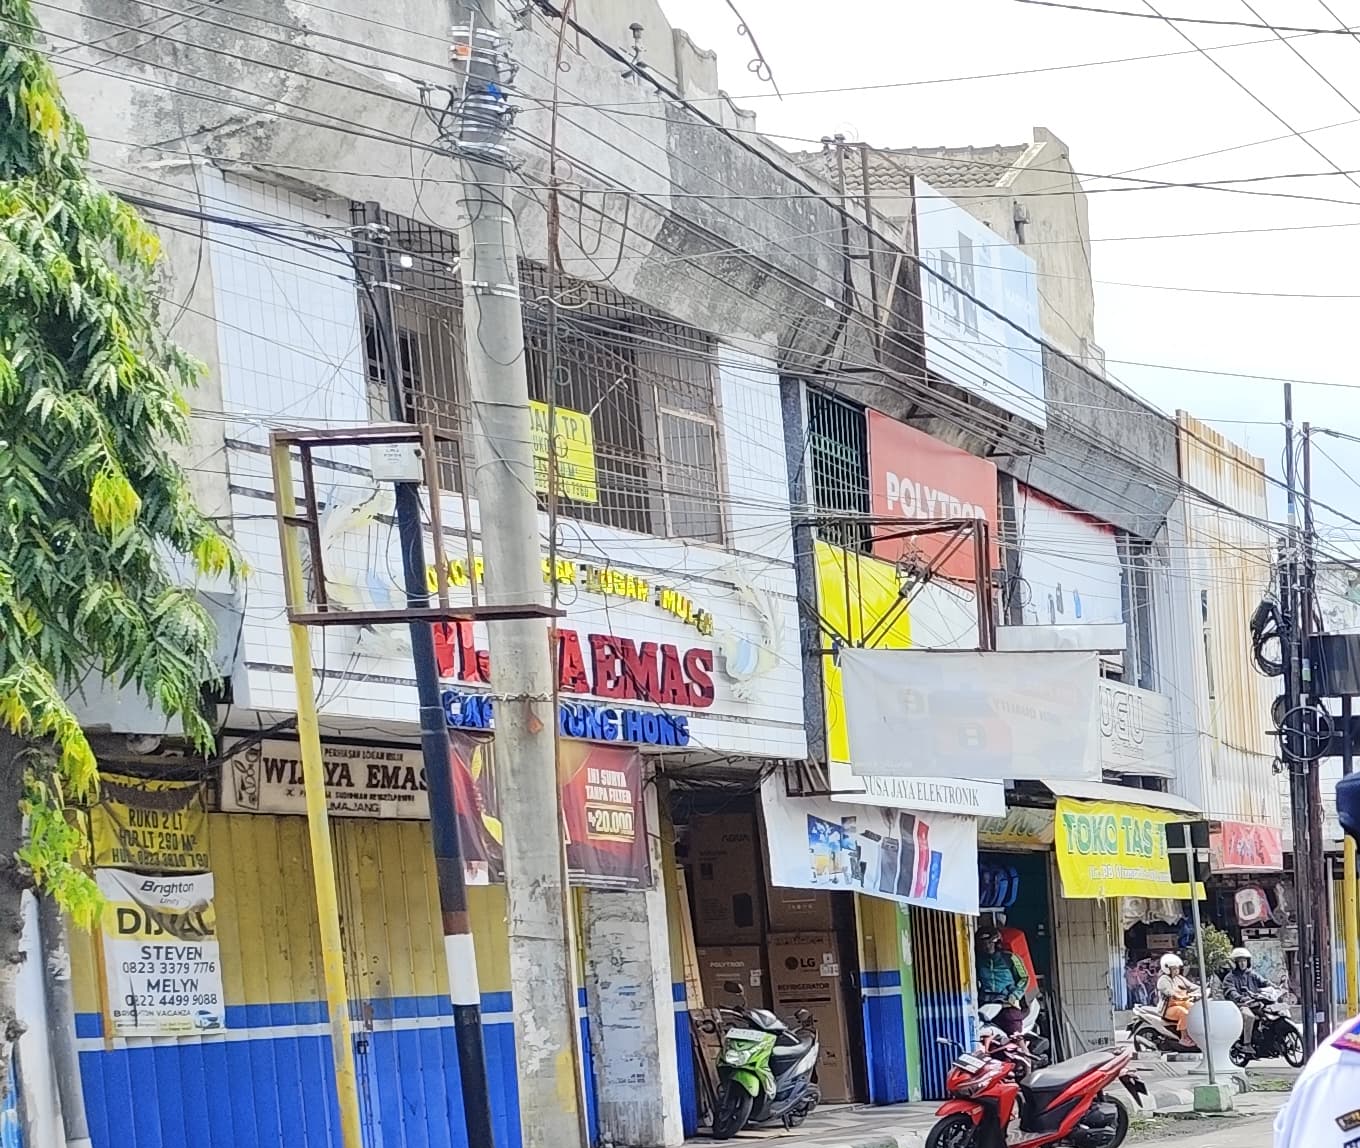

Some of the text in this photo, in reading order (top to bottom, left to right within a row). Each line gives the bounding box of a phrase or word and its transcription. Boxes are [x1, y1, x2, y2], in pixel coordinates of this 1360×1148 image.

[891, 778, 915, 801] JAYA
[917, 782, 980, 808] ELEKTRONIK
[1063, 812, 1118, 855] TOKO
[1121, 816, 1153, 858] TAS
[140, 880, 194, 897] Brighton
[141, 945, 203, 961] STEVEN
[122, 961, 155, 974] 0823
[159, 961, 190, 974] 3379
[801, 957, 816, 968] LG
[146, 978, 199, 993] MELYN
[158, 995, 190, 1007] 4499
